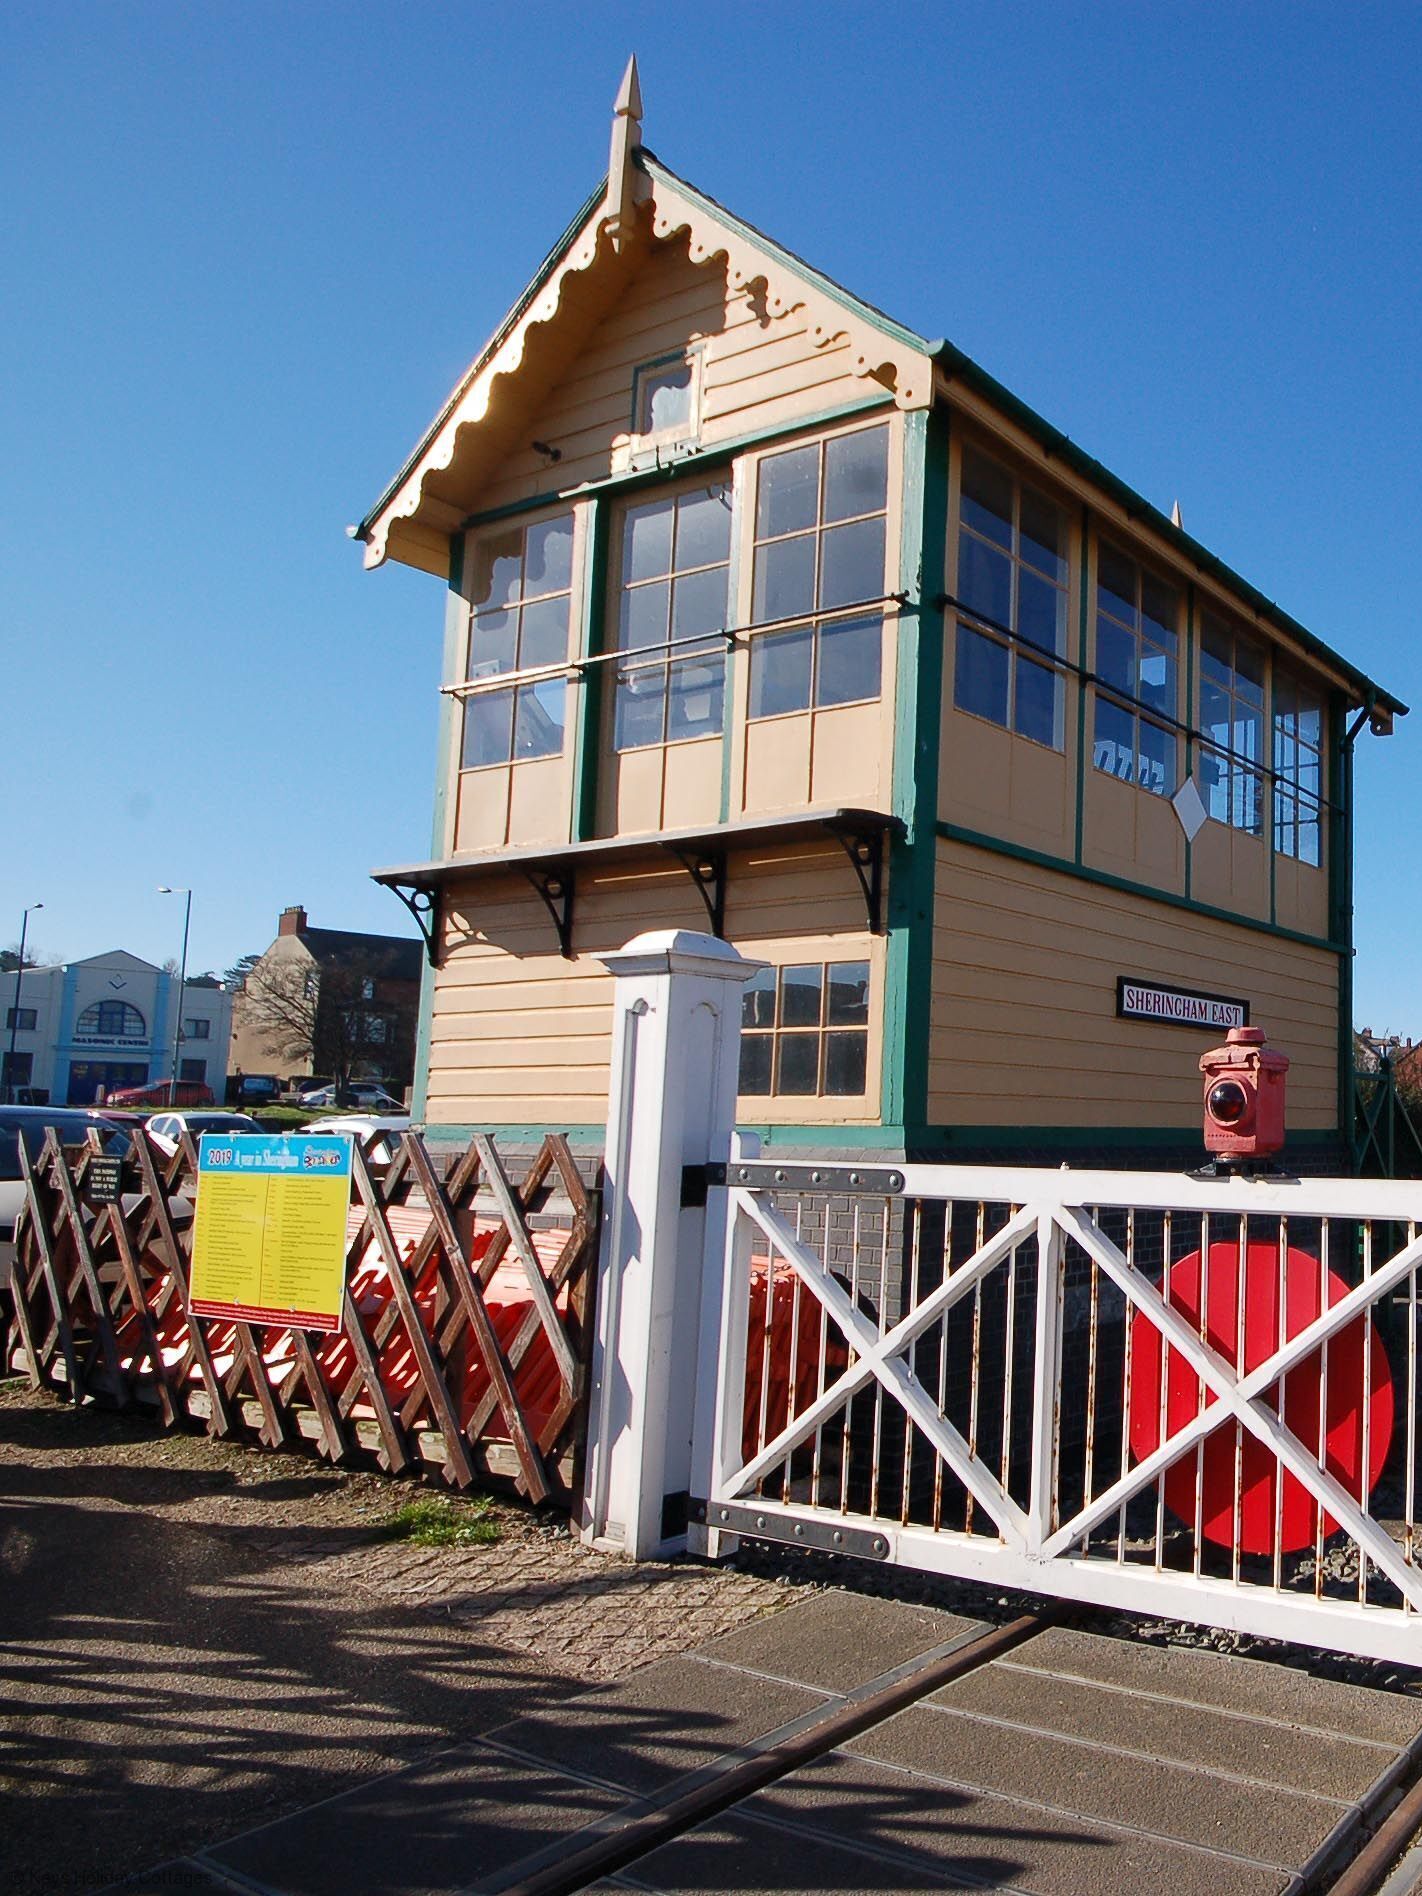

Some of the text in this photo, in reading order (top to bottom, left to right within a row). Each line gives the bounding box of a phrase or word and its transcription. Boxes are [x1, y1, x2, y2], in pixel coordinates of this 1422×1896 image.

[1126, 988, 1241, 1026] SHERINGHAM EAST
[209, 1149, 232, 1165] 2019
